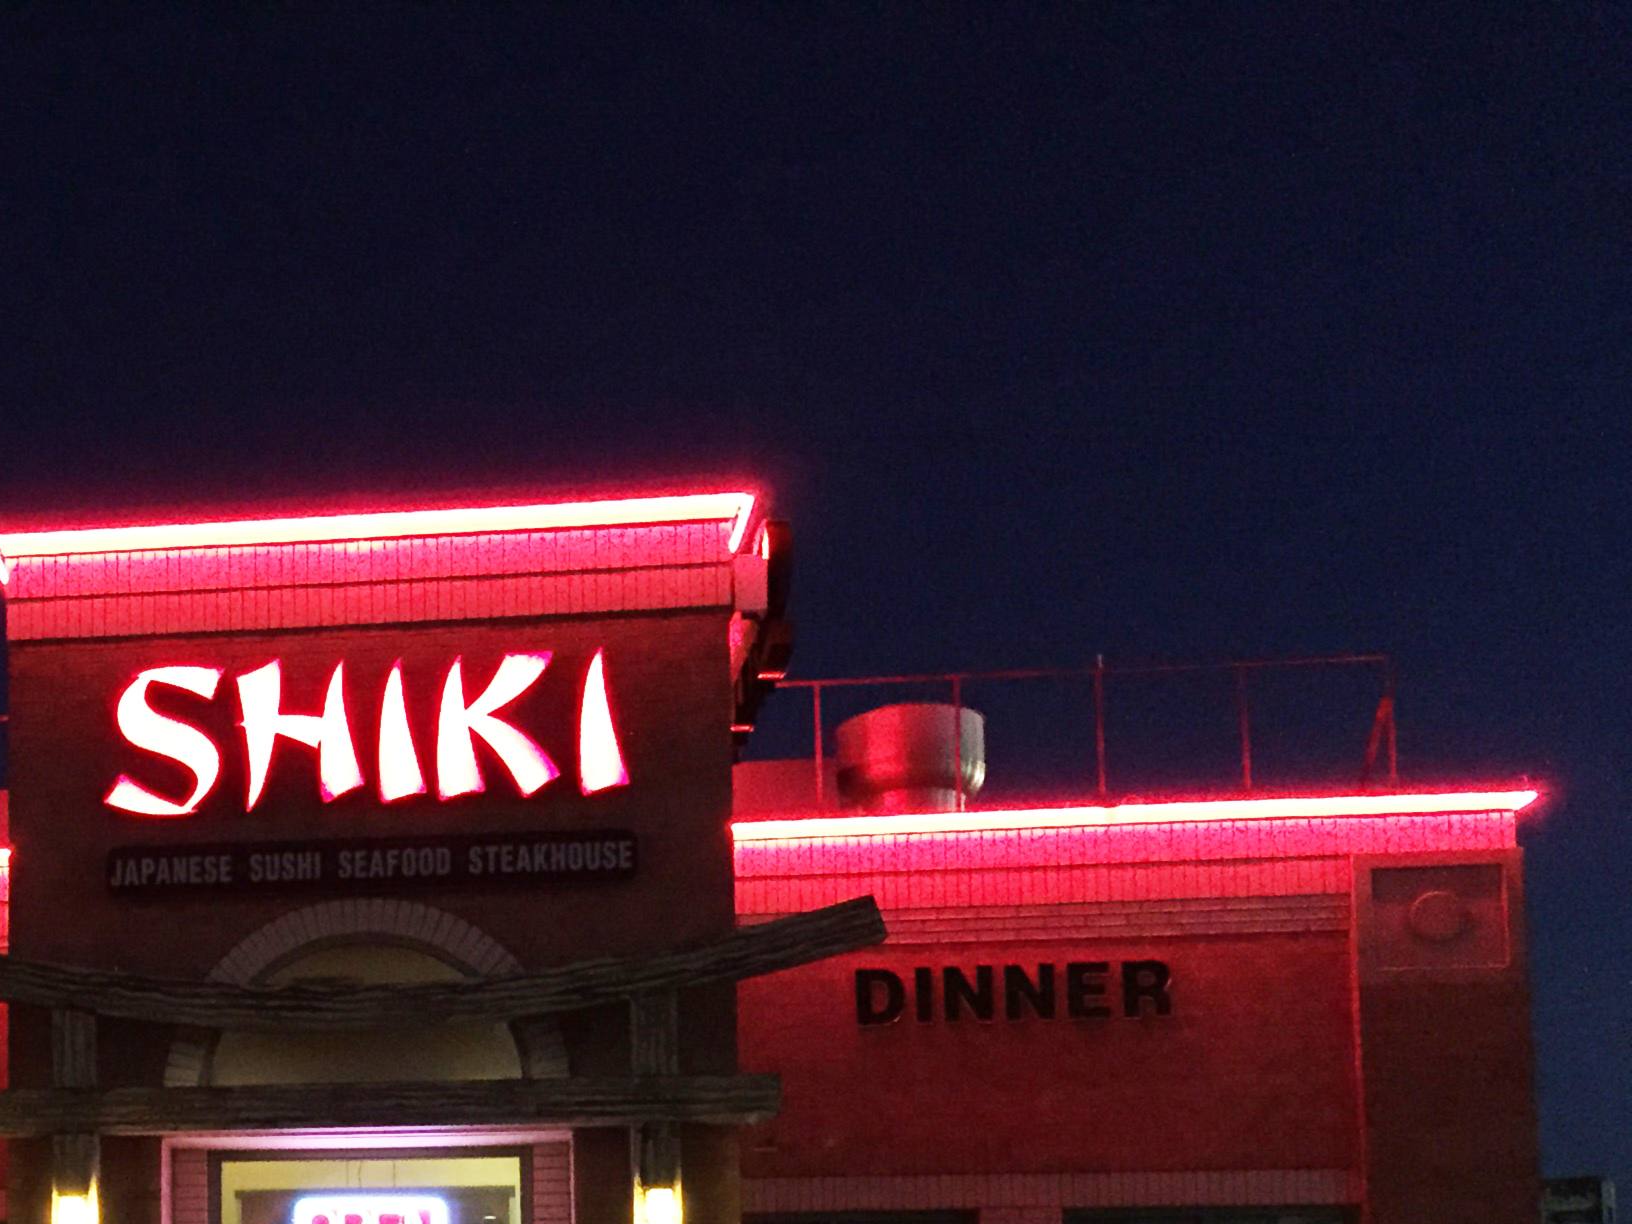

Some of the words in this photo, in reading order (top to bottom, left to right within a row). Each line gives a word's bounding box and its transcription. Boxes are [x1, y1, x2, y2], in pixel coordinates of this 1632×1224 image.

[103, 647, 630, 816] SHIKI
[110, 855, 233, 887] JAPANESE
[248, 851, 323, 882] SUSHI
[337, 847, 452, 879] SEAFOOD
[468, 840, 634, 875] STEAKHOUSE
[855, 960, 1173, 1025] DINNER
